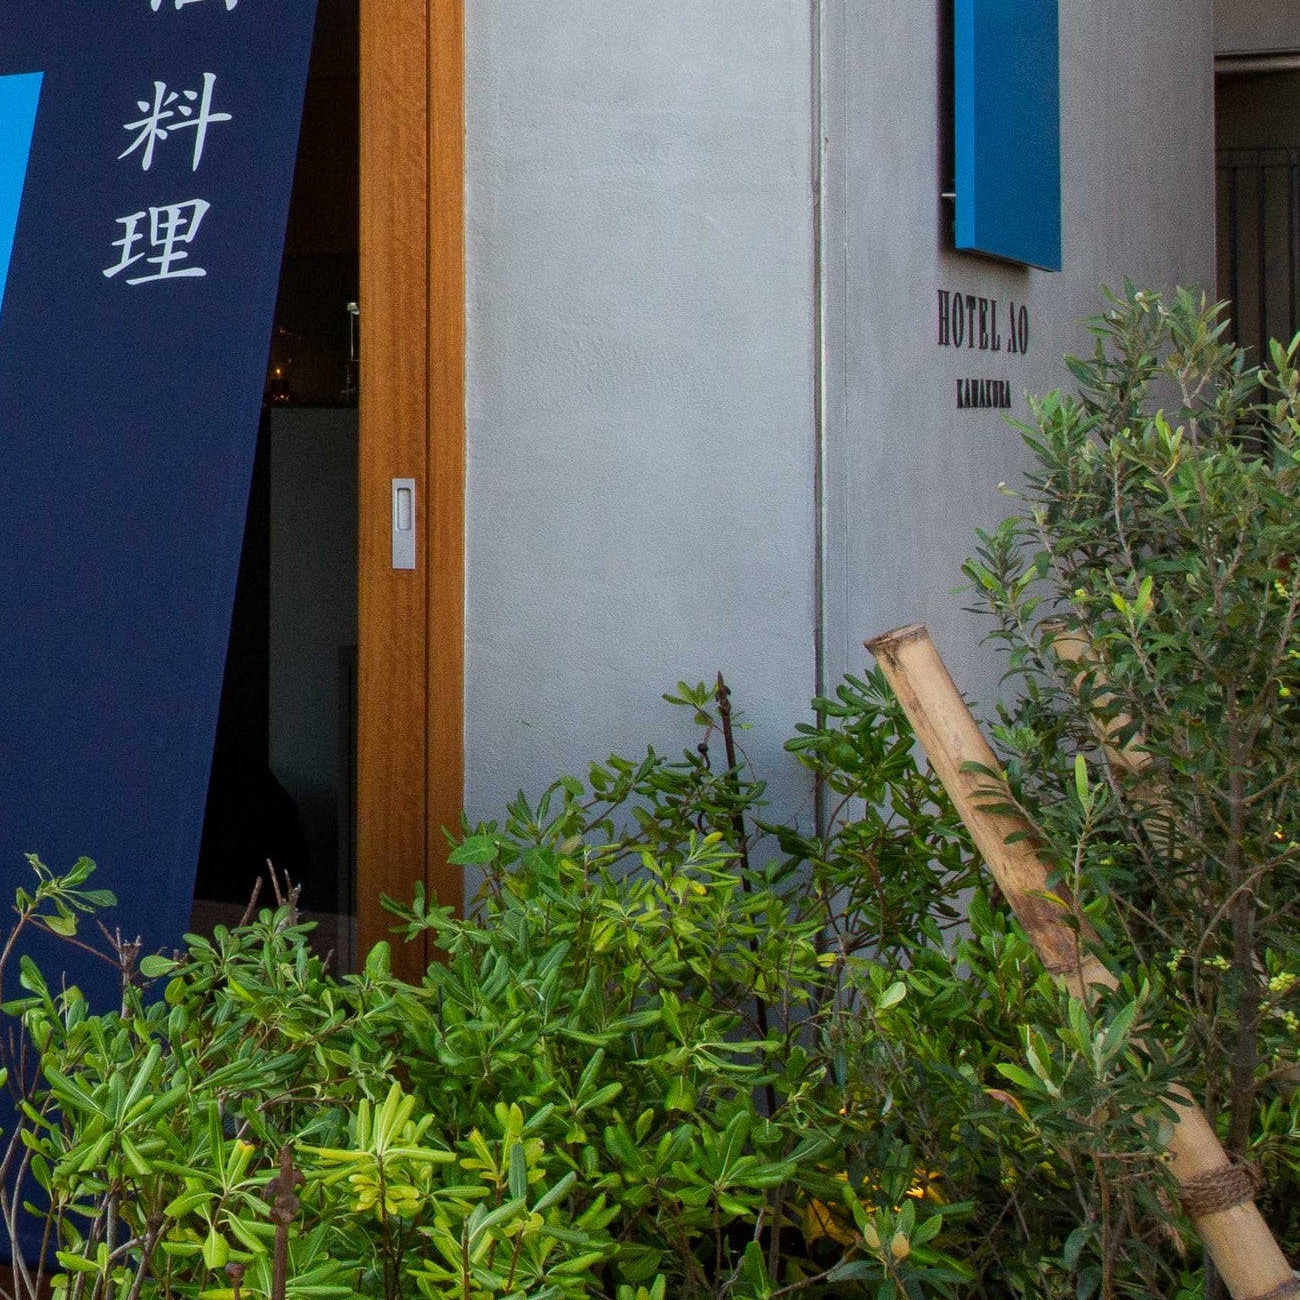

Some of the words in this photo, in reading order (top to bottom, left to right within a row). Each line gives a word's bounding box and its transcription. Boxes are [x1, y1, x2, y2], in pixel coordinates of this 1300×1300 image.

[102, 71, 233, 286] 料理
[937, 289, 1001, 352] HOTEL
[956, 378, 1012, 410] KAMAKURA
